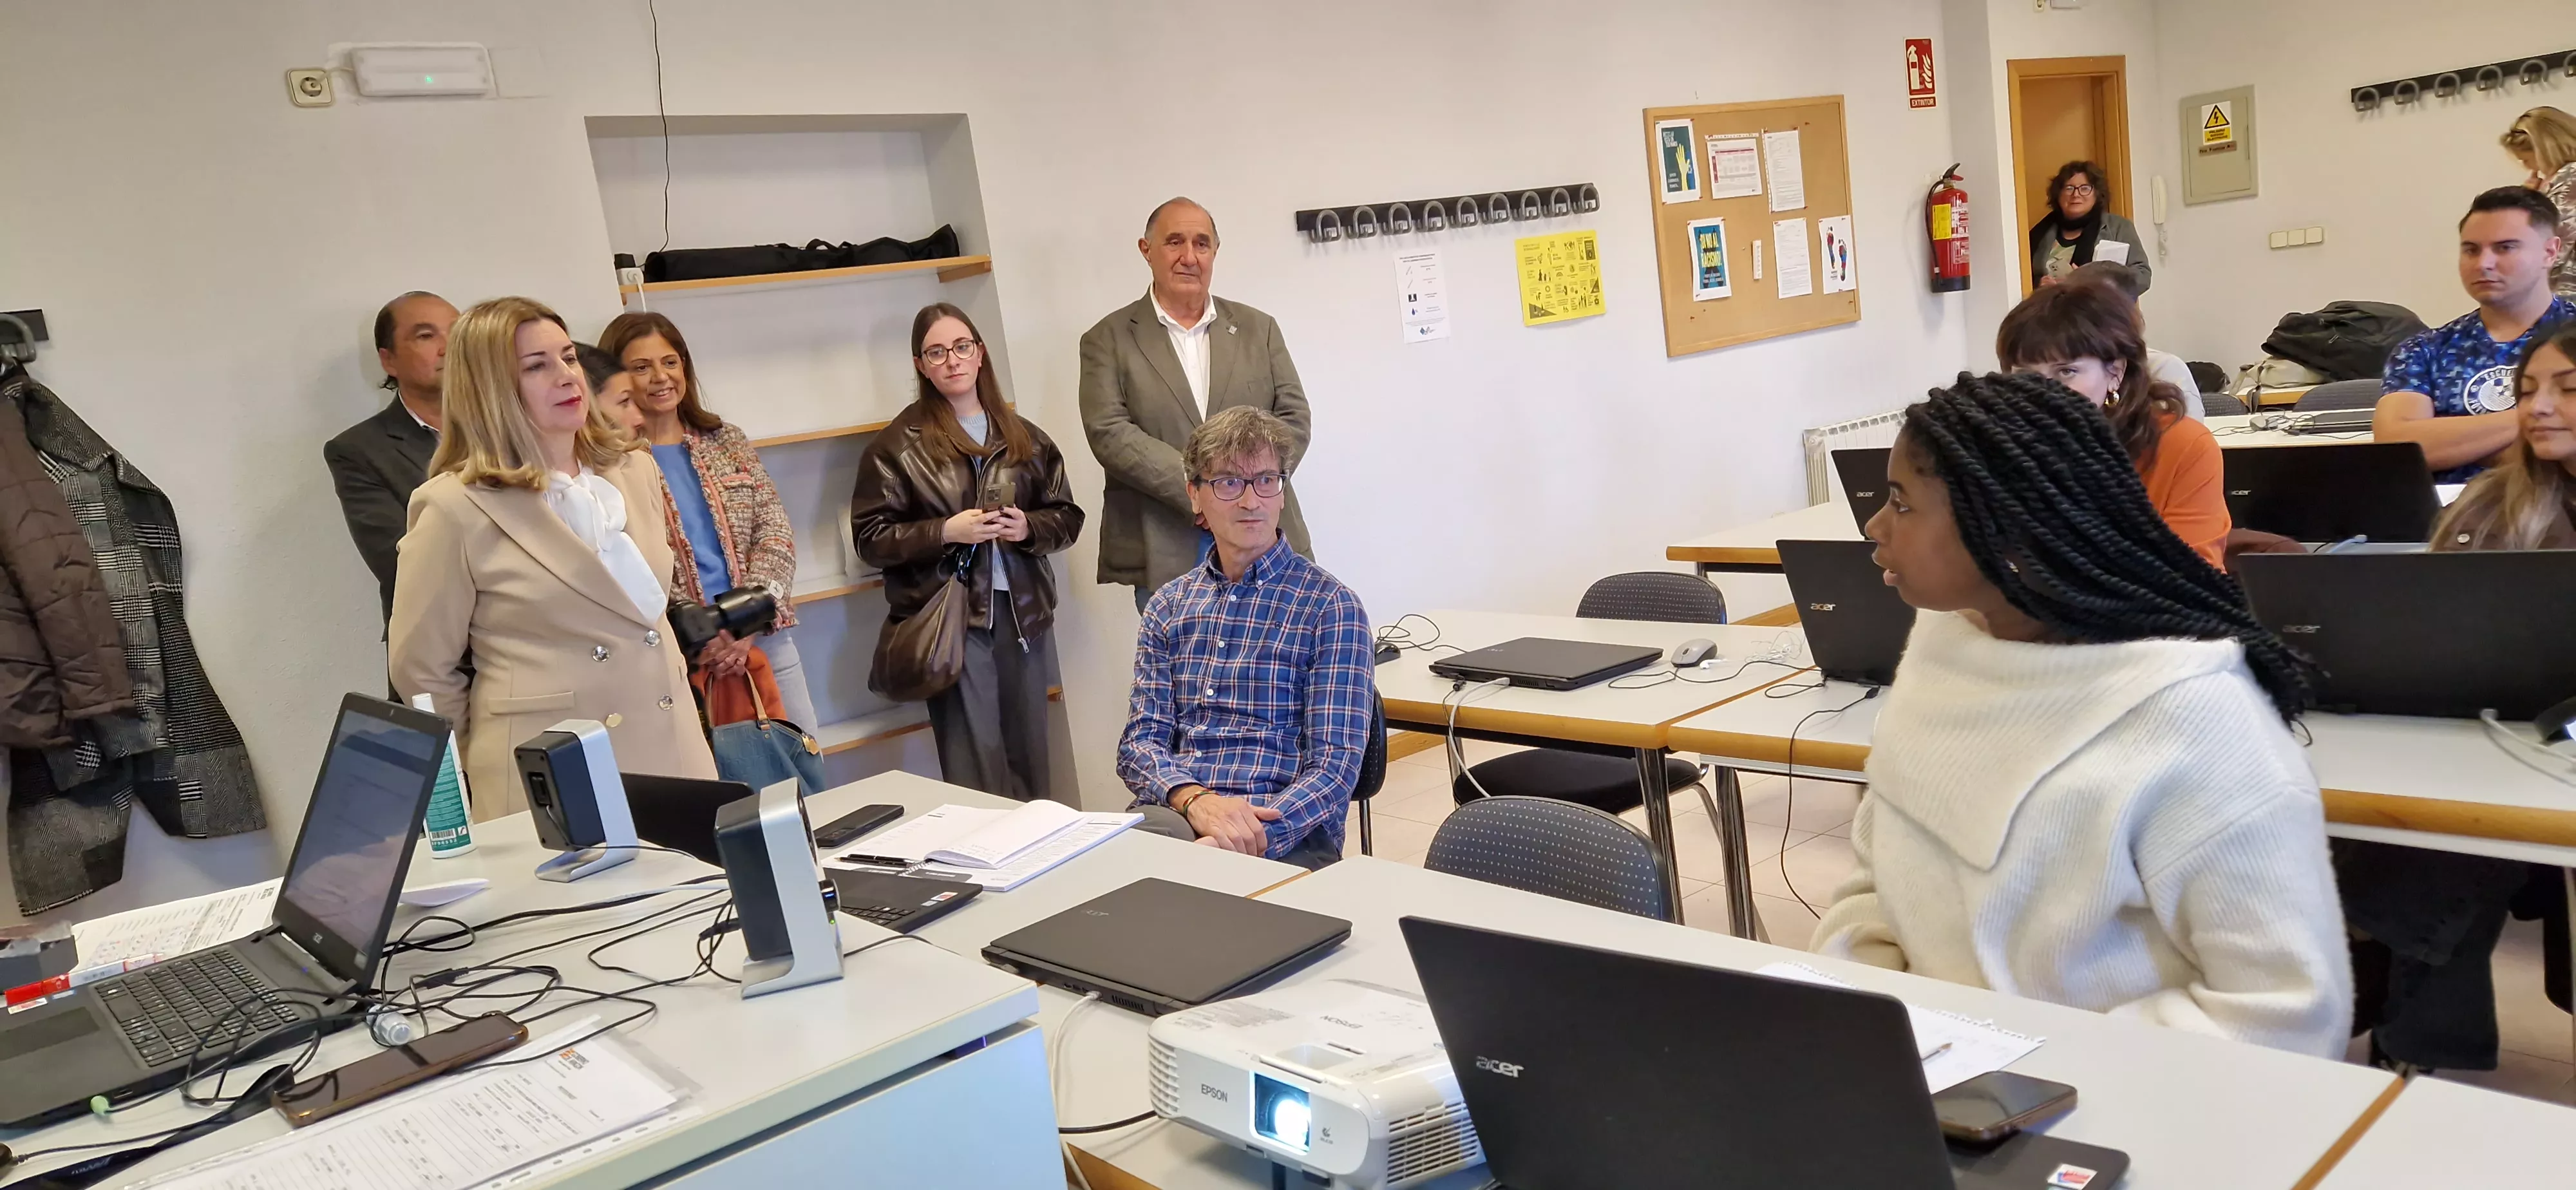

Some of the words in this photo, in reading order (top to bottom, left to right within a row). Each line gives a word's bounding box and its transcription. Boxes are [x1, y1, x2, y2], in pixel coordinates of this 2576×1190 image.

[2484, 369, 2514, 380] ESCUE
[1475, 1056, 1524, 1077] acer
[1201, 1084, 1227, 1102] EPSON
